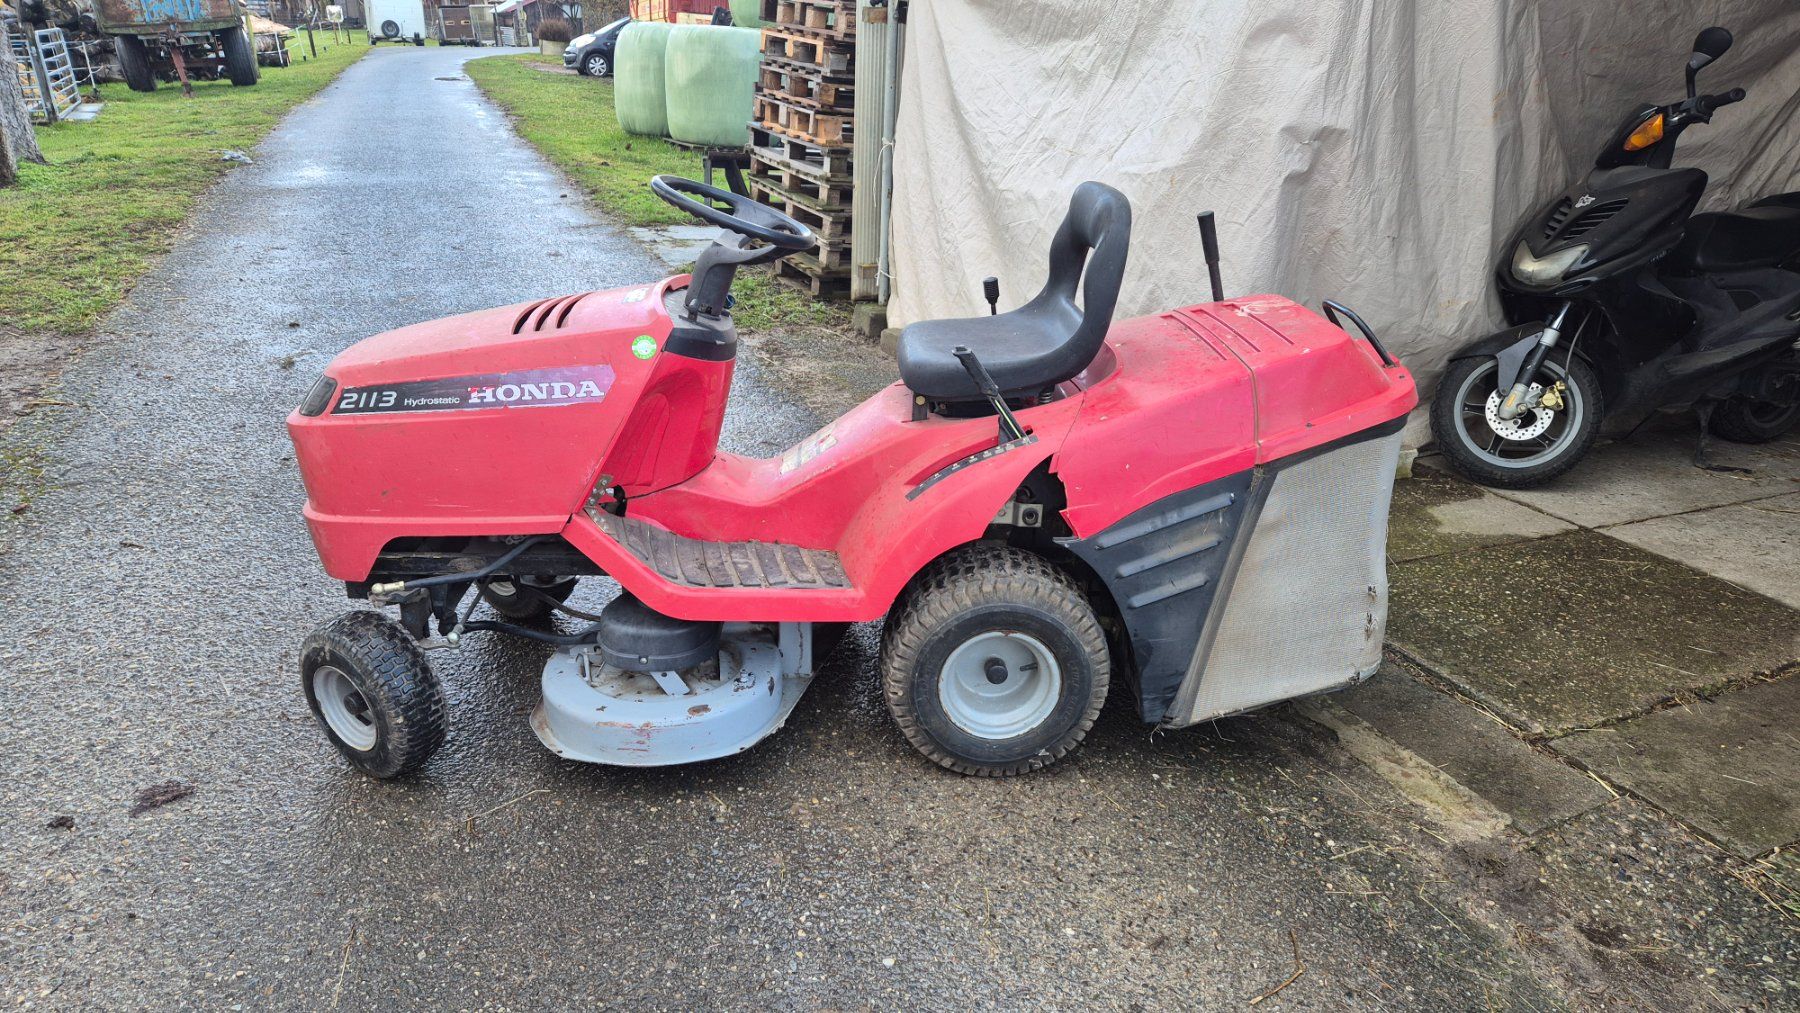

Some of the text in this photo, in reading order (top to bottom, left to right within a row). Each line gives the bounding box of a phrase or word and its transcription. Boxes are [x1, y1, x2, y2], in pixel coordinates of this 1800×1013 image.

[340, 380, 605, 409] 2113 Hydrostatic HONDA
